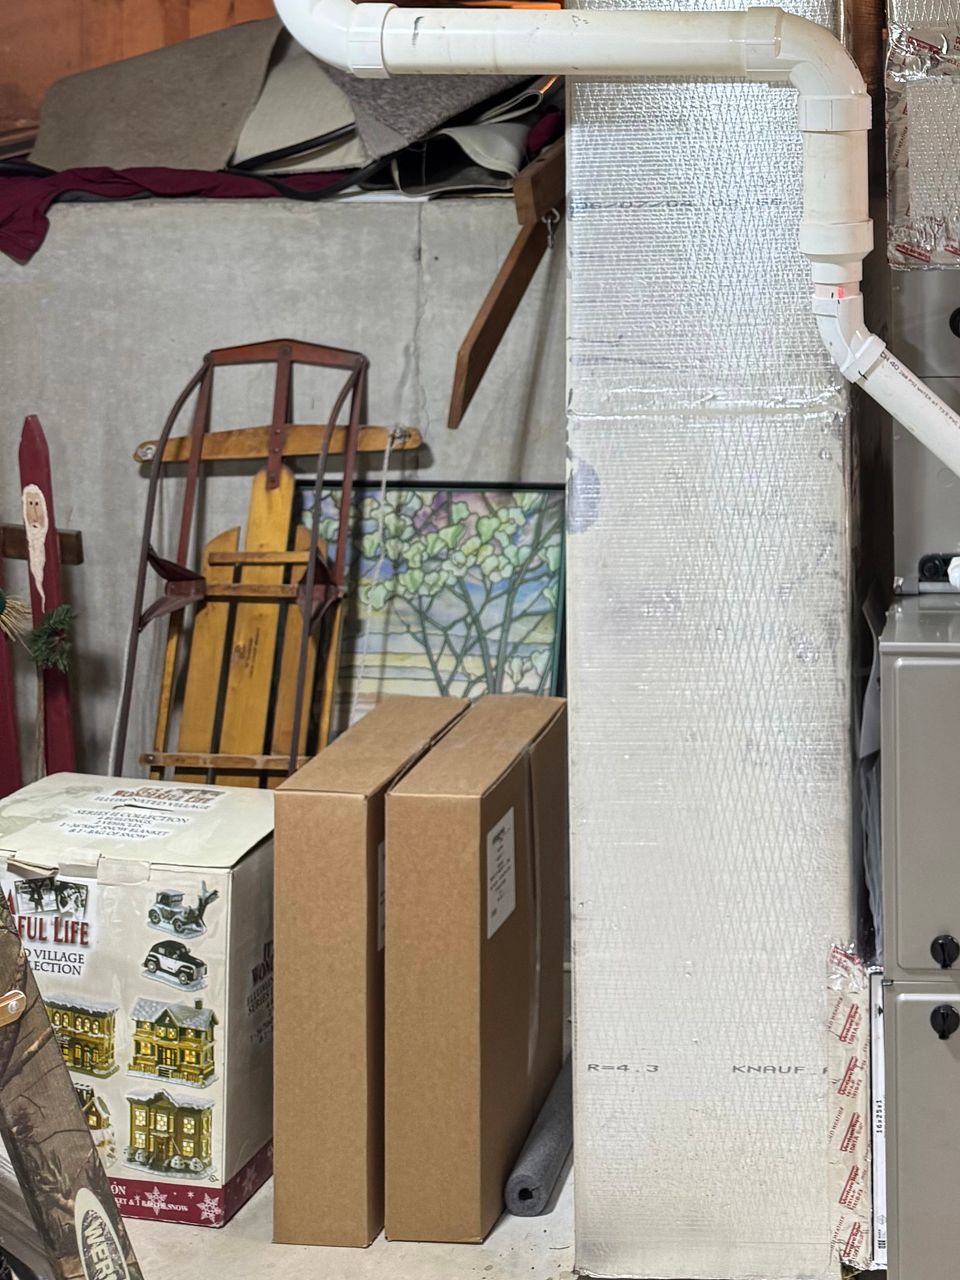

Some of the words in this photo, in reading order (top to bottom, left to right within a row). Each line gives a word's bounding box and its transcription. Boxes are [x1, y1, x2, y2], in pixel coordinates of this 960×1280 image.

[53, 916, 89, 946] LIFE
[34, 949, 85, 964] VILLAGE
[732, 1064, 805, 1075] KNAUF
[875, 1099, 884, 1134] 16x25x1
